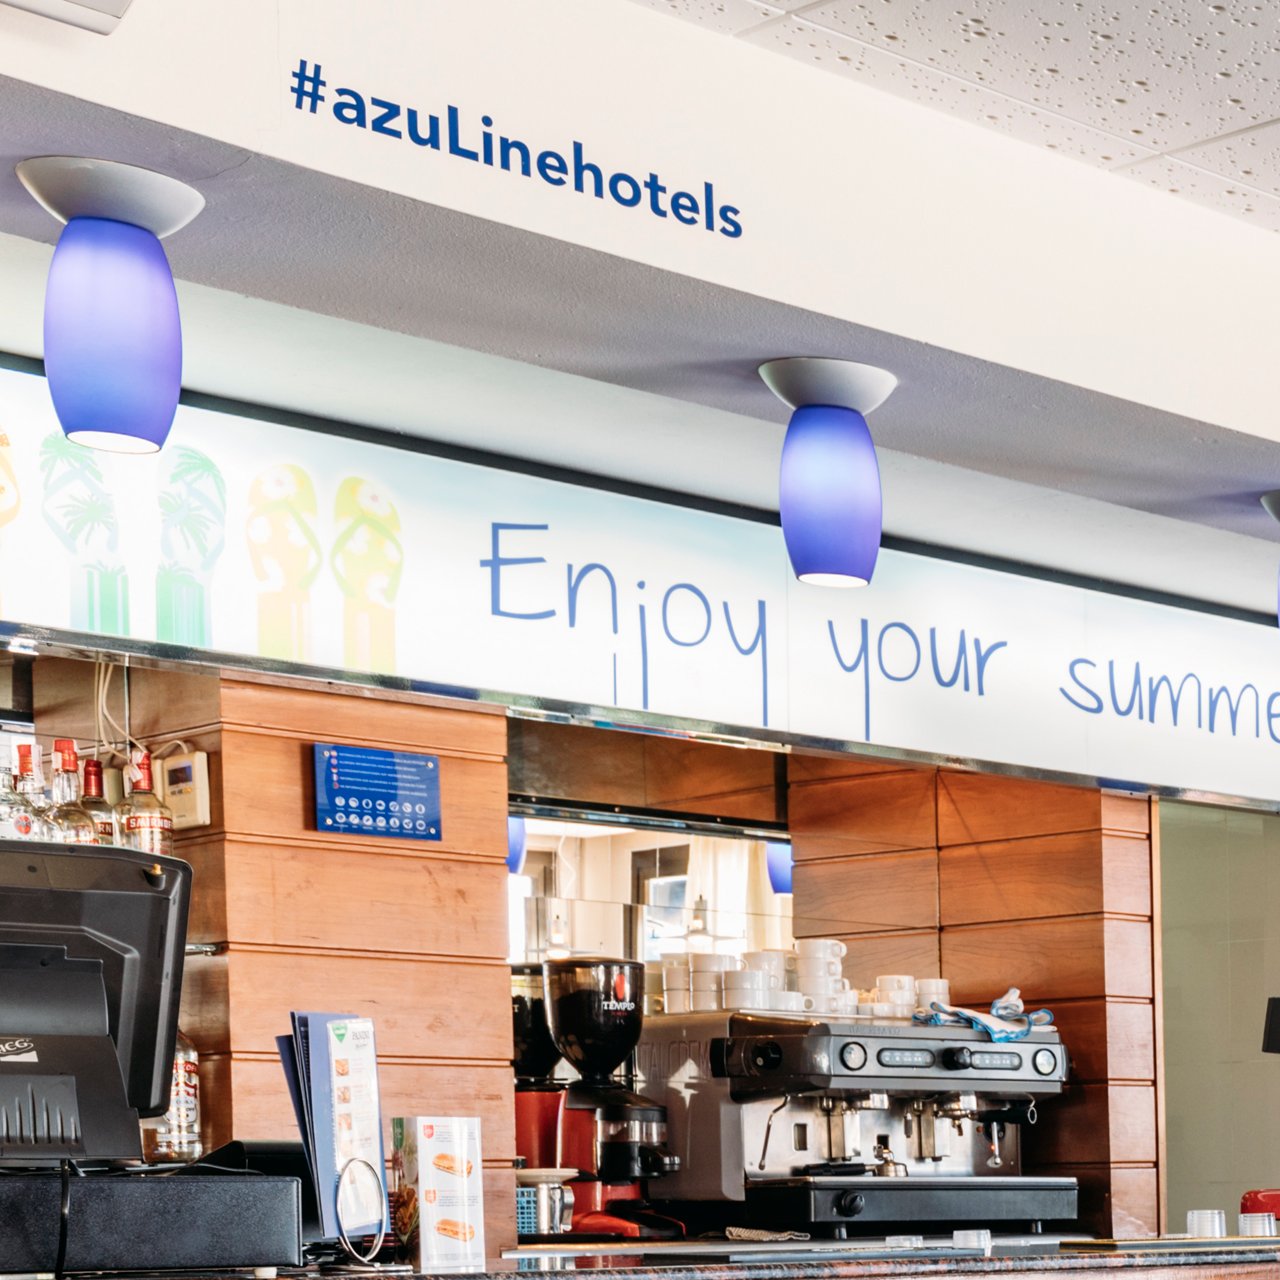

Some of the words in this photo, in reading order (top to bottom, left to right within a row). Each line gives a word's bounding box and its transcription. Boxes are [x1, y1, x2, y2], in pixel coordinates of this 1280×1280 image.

[290, 58, 743, 239] #azuLinehotels
[479, 522, 769, 728] Enjoy
[826, 618, 1008, 742] your
[602, 1000, 635, 1010] TEMPLO
